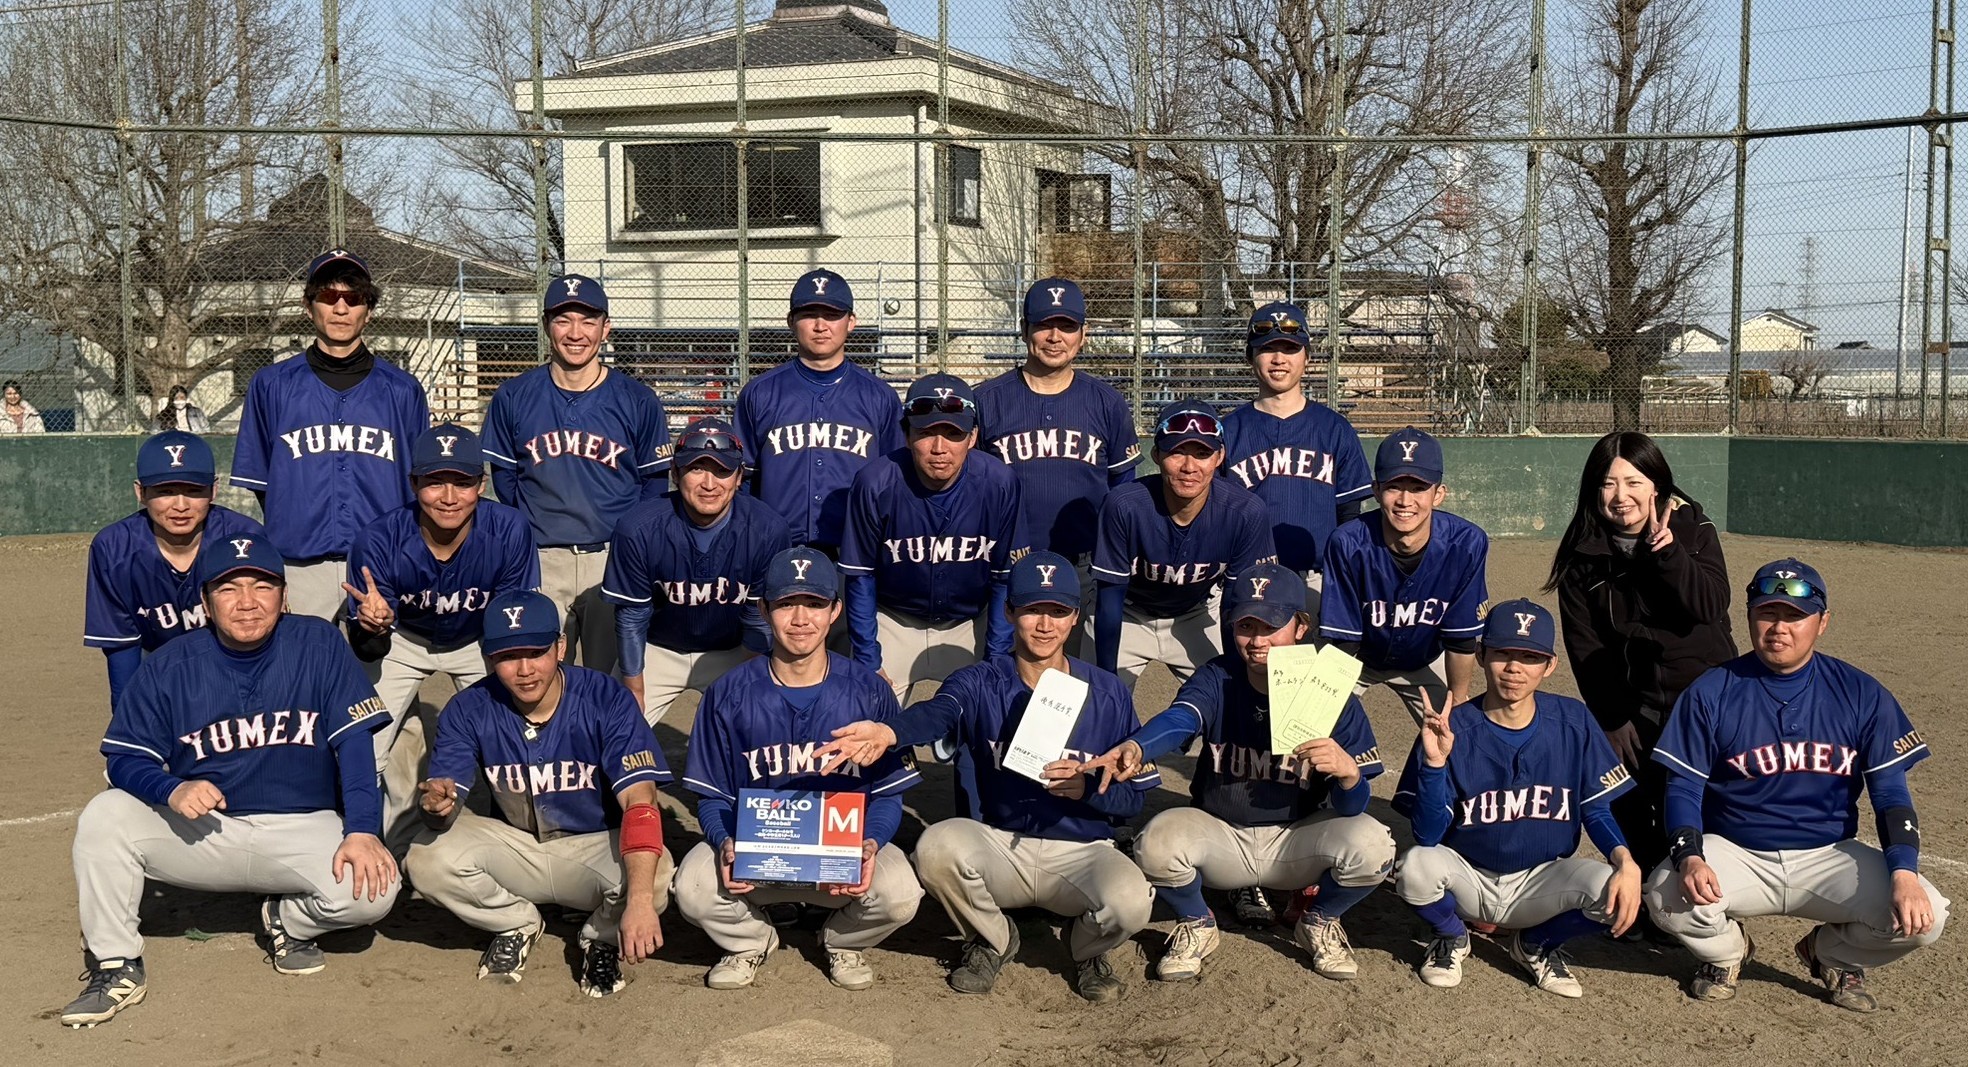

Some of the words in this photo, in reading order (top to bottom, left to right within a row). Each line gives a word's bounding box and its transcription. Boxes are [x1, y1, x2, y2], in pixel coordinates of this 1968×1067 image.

[563, 278, 582, 297] Y
[812, 277, 829, 294] Y
[1047, 287, 1066, 306] Y
[280, 424, 395, 462] YUMEX
[436, 435, 458, 457] Y
[525, 430, 628, 470] YUMEX
[768, 423, 873, 458] YUMEX
[993, 428, 1103, 466] YUMEX
[1399, 440, 1419, 462] Y
[164, 444, 187, 468] Y
[1229, 447, 1334, 489] YUMEX
[229, 538, 253, 560] Y
[884, 535, 997, 565] YUMEX
[790, 559, 812, 580] Y
[1036, 565, 1057, 587] Y
[1250, 577, 1271, 600] Y
[502, 606, 524, 629] Y
[1514, 612, 1537, 636] Y
[179, 709, 320, 761] YUMEX
[1726, 741, 1858, 780] YUMEX
[485, 760, 598, 796] YUMEX
[756, 809, 801, 821] BALL
[1461, 785, 1573, 827] YUMEX
[827, 806, 859, 833] M
